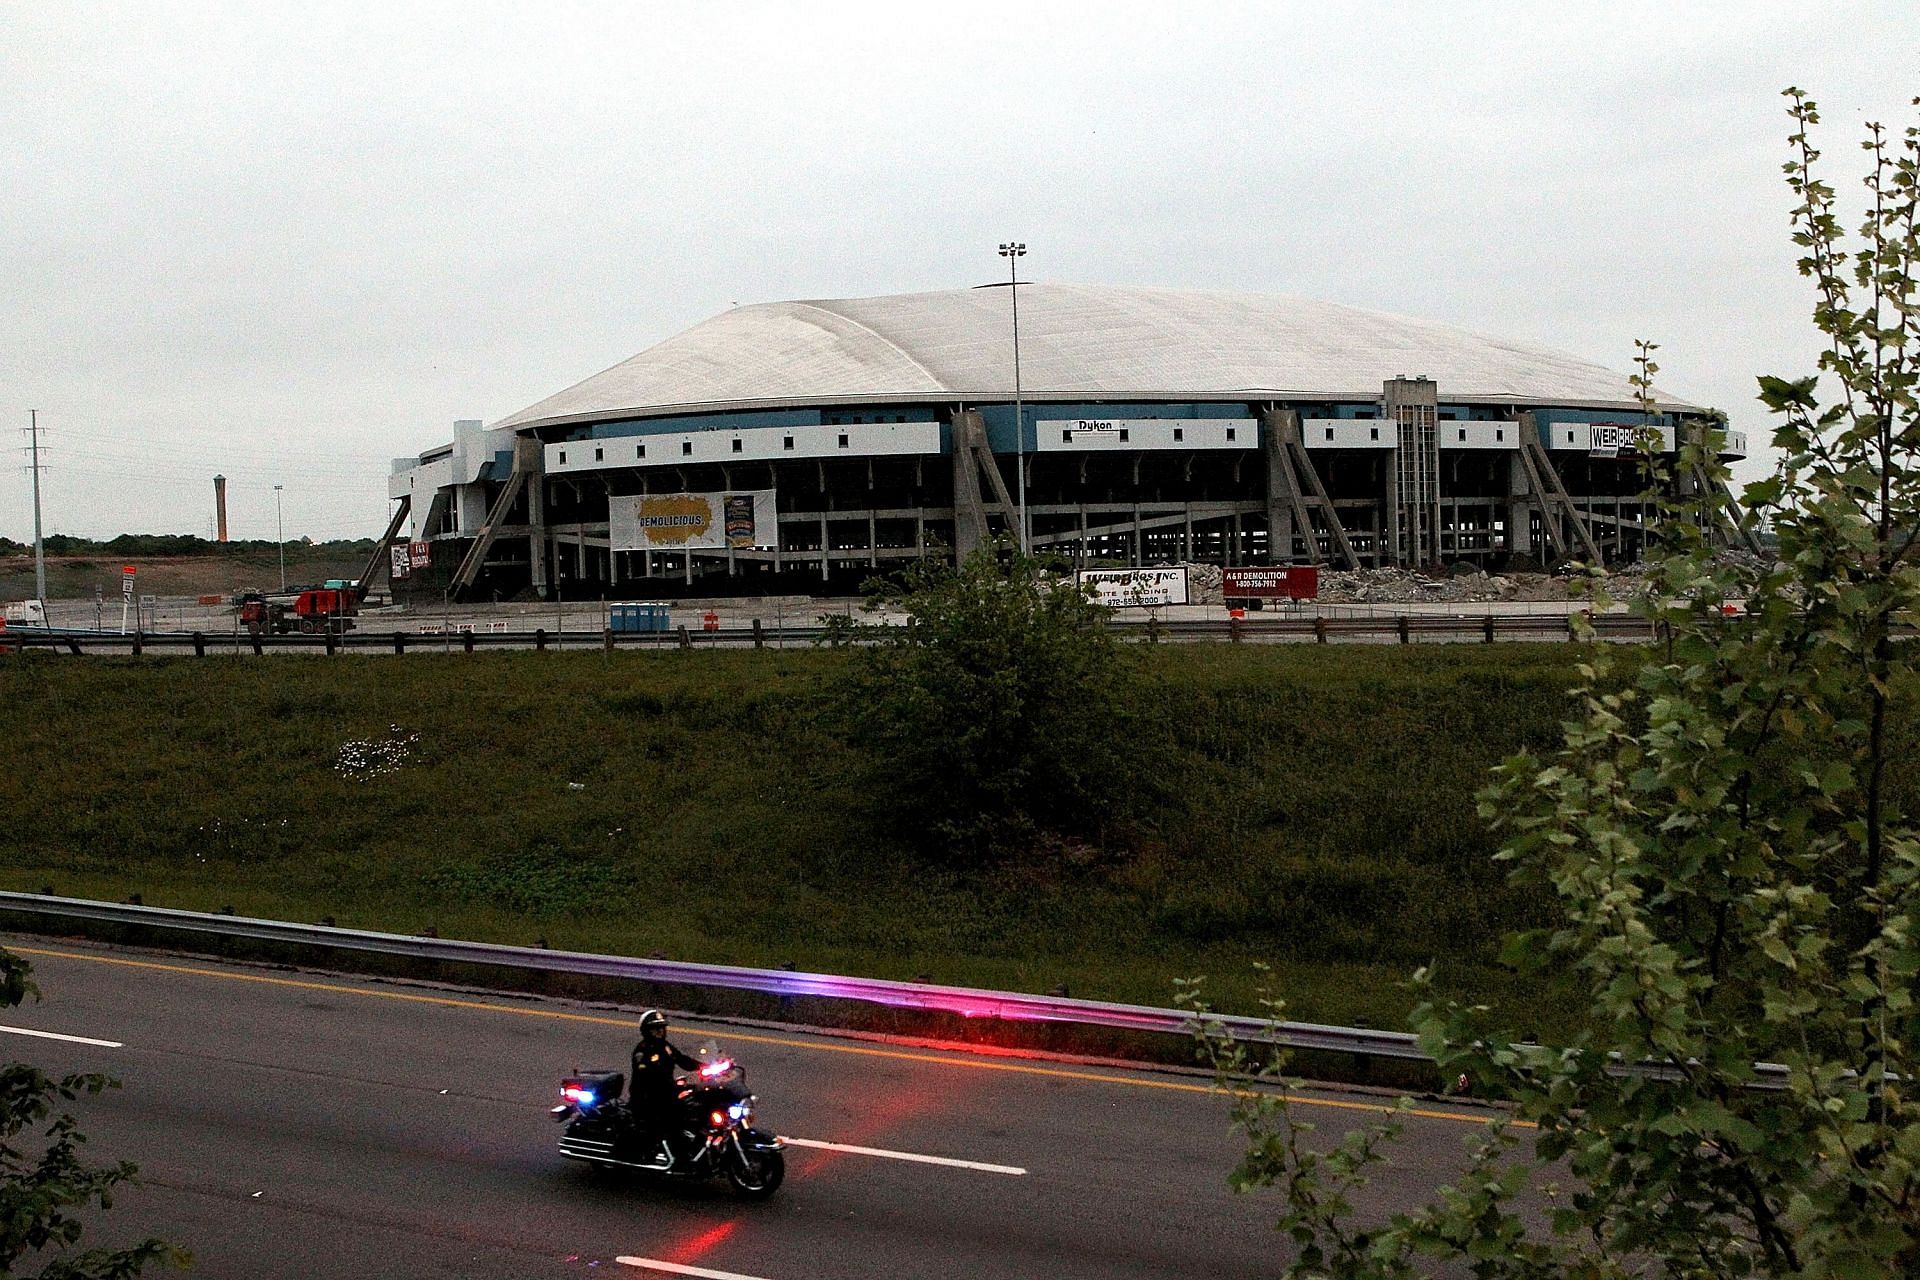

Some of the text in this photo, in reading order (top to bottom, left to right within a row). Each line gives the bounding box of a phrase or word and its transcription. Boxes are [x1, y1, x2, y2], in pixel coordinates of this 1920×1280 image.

[1078, 420, 1112, 431] Dykon
[1592, 428, 1617, 447] WEIR
[640, 515, 704, 527] DEMOLICIOUS.
[1154, 572, 1179, 585] INC.
[1243, 571, 1287, 580] DEMOLITION
